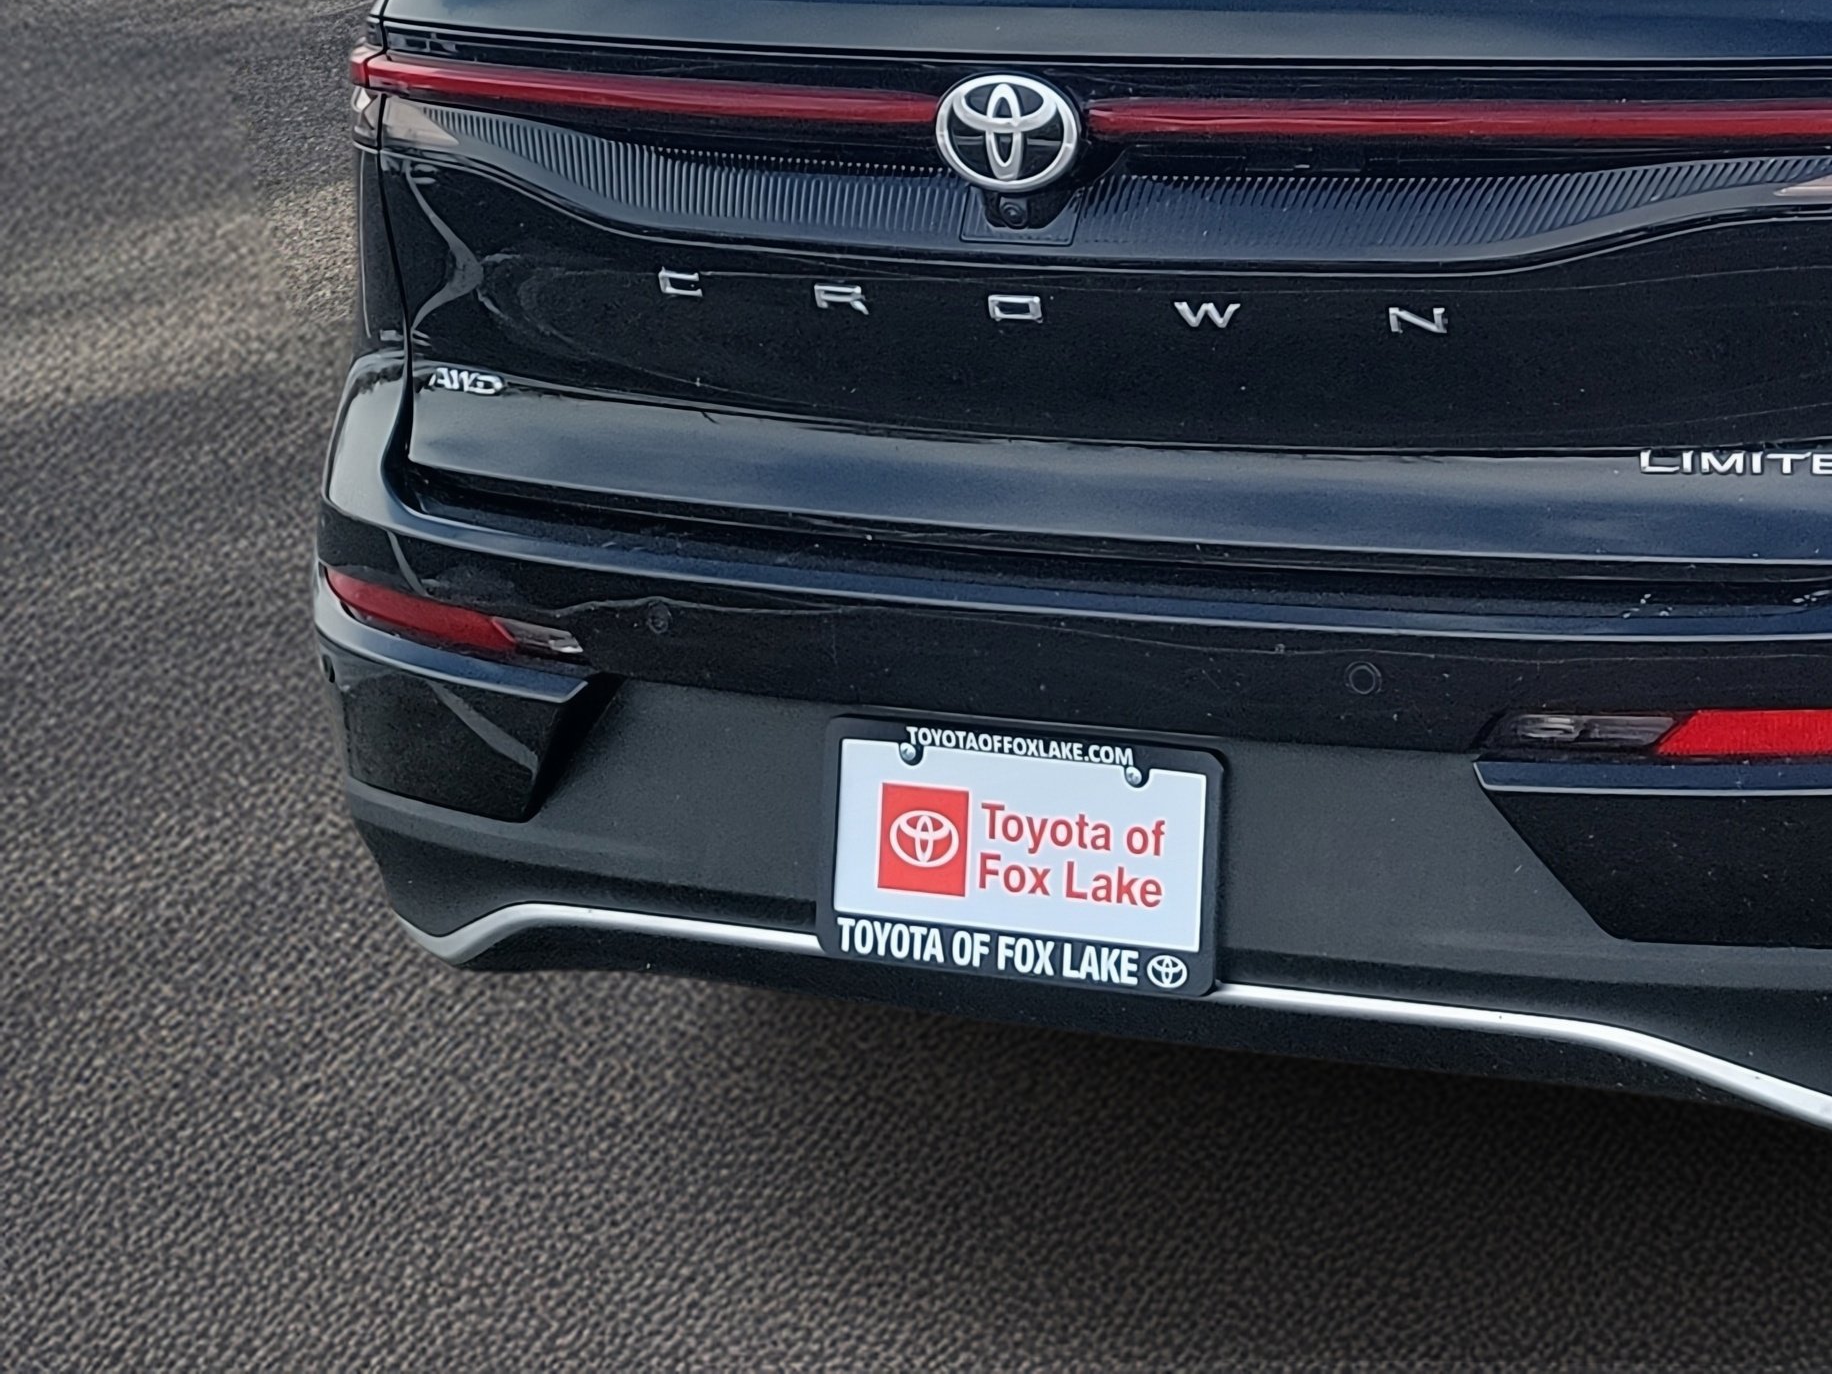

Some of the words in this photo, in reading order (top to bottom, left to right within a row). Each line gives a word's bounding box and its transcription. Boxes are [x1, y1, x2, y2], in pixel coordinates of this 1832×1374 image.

[658, 266, 1448, 334] CROWN
[906, 726, 1135, 767] TOYOTAOFFOXLAKE.COM
[981, 802, 1112, 854] Toyota
[1125, 820, 1166, 856] of
[978, 852, 1051, 896] Fox
[1065, 860, 1163, 908] Lake
[837, 917, 944, 963] TOYOTA
[951, 933, 991, 967] OF
[997, 935, 1055, 975] FOX
[1062, 942, 1140, 986] LAKE
